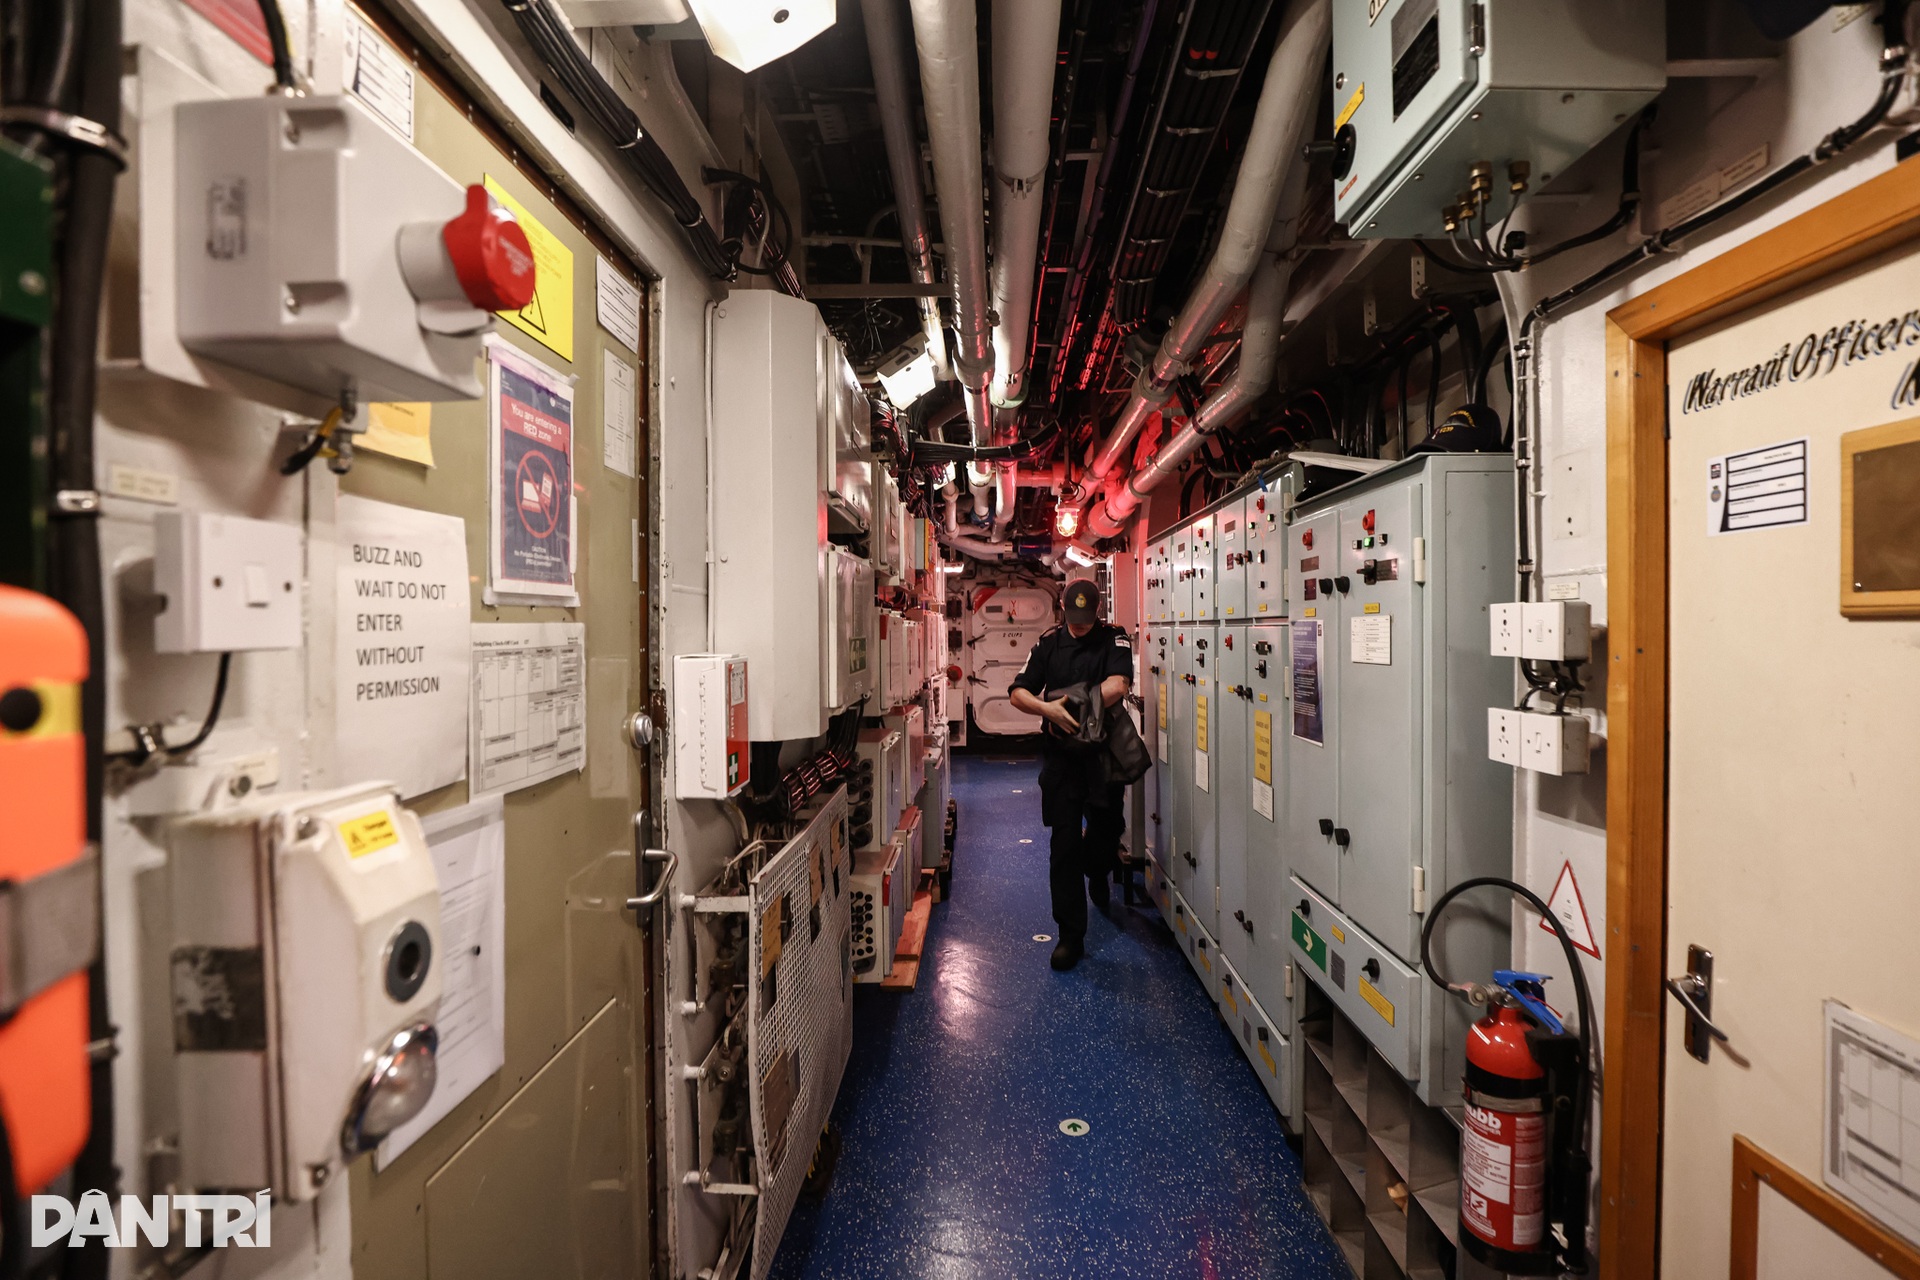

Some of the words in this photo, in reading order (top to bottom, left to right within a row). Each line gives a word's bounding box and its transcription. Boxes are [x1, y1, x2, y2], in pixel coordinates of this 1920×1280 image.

[1683, 343, 1791, 415] Warrant
[511, 402, 524, 418] You
[524, 410, 534, 422] are
[535, 416, 557, 435] entering
[523, 421, 537, 437] RED
[537, 430, 552, 442] zone
[353, 544, 390, 565] BUZZ
[394, 549, 423, 568] AND
[355, 579, 393, 598] WAIT
[398, 581, 417, 599] DO
[421, 583, 446, 600] NOT
[356, 613, 403, 632] ENTER
[356, 646, 425, 667] WITHOUT
[356, 676, 440, 701] PERMISSION
[1464, 1104, 1502, 1130] ubb
